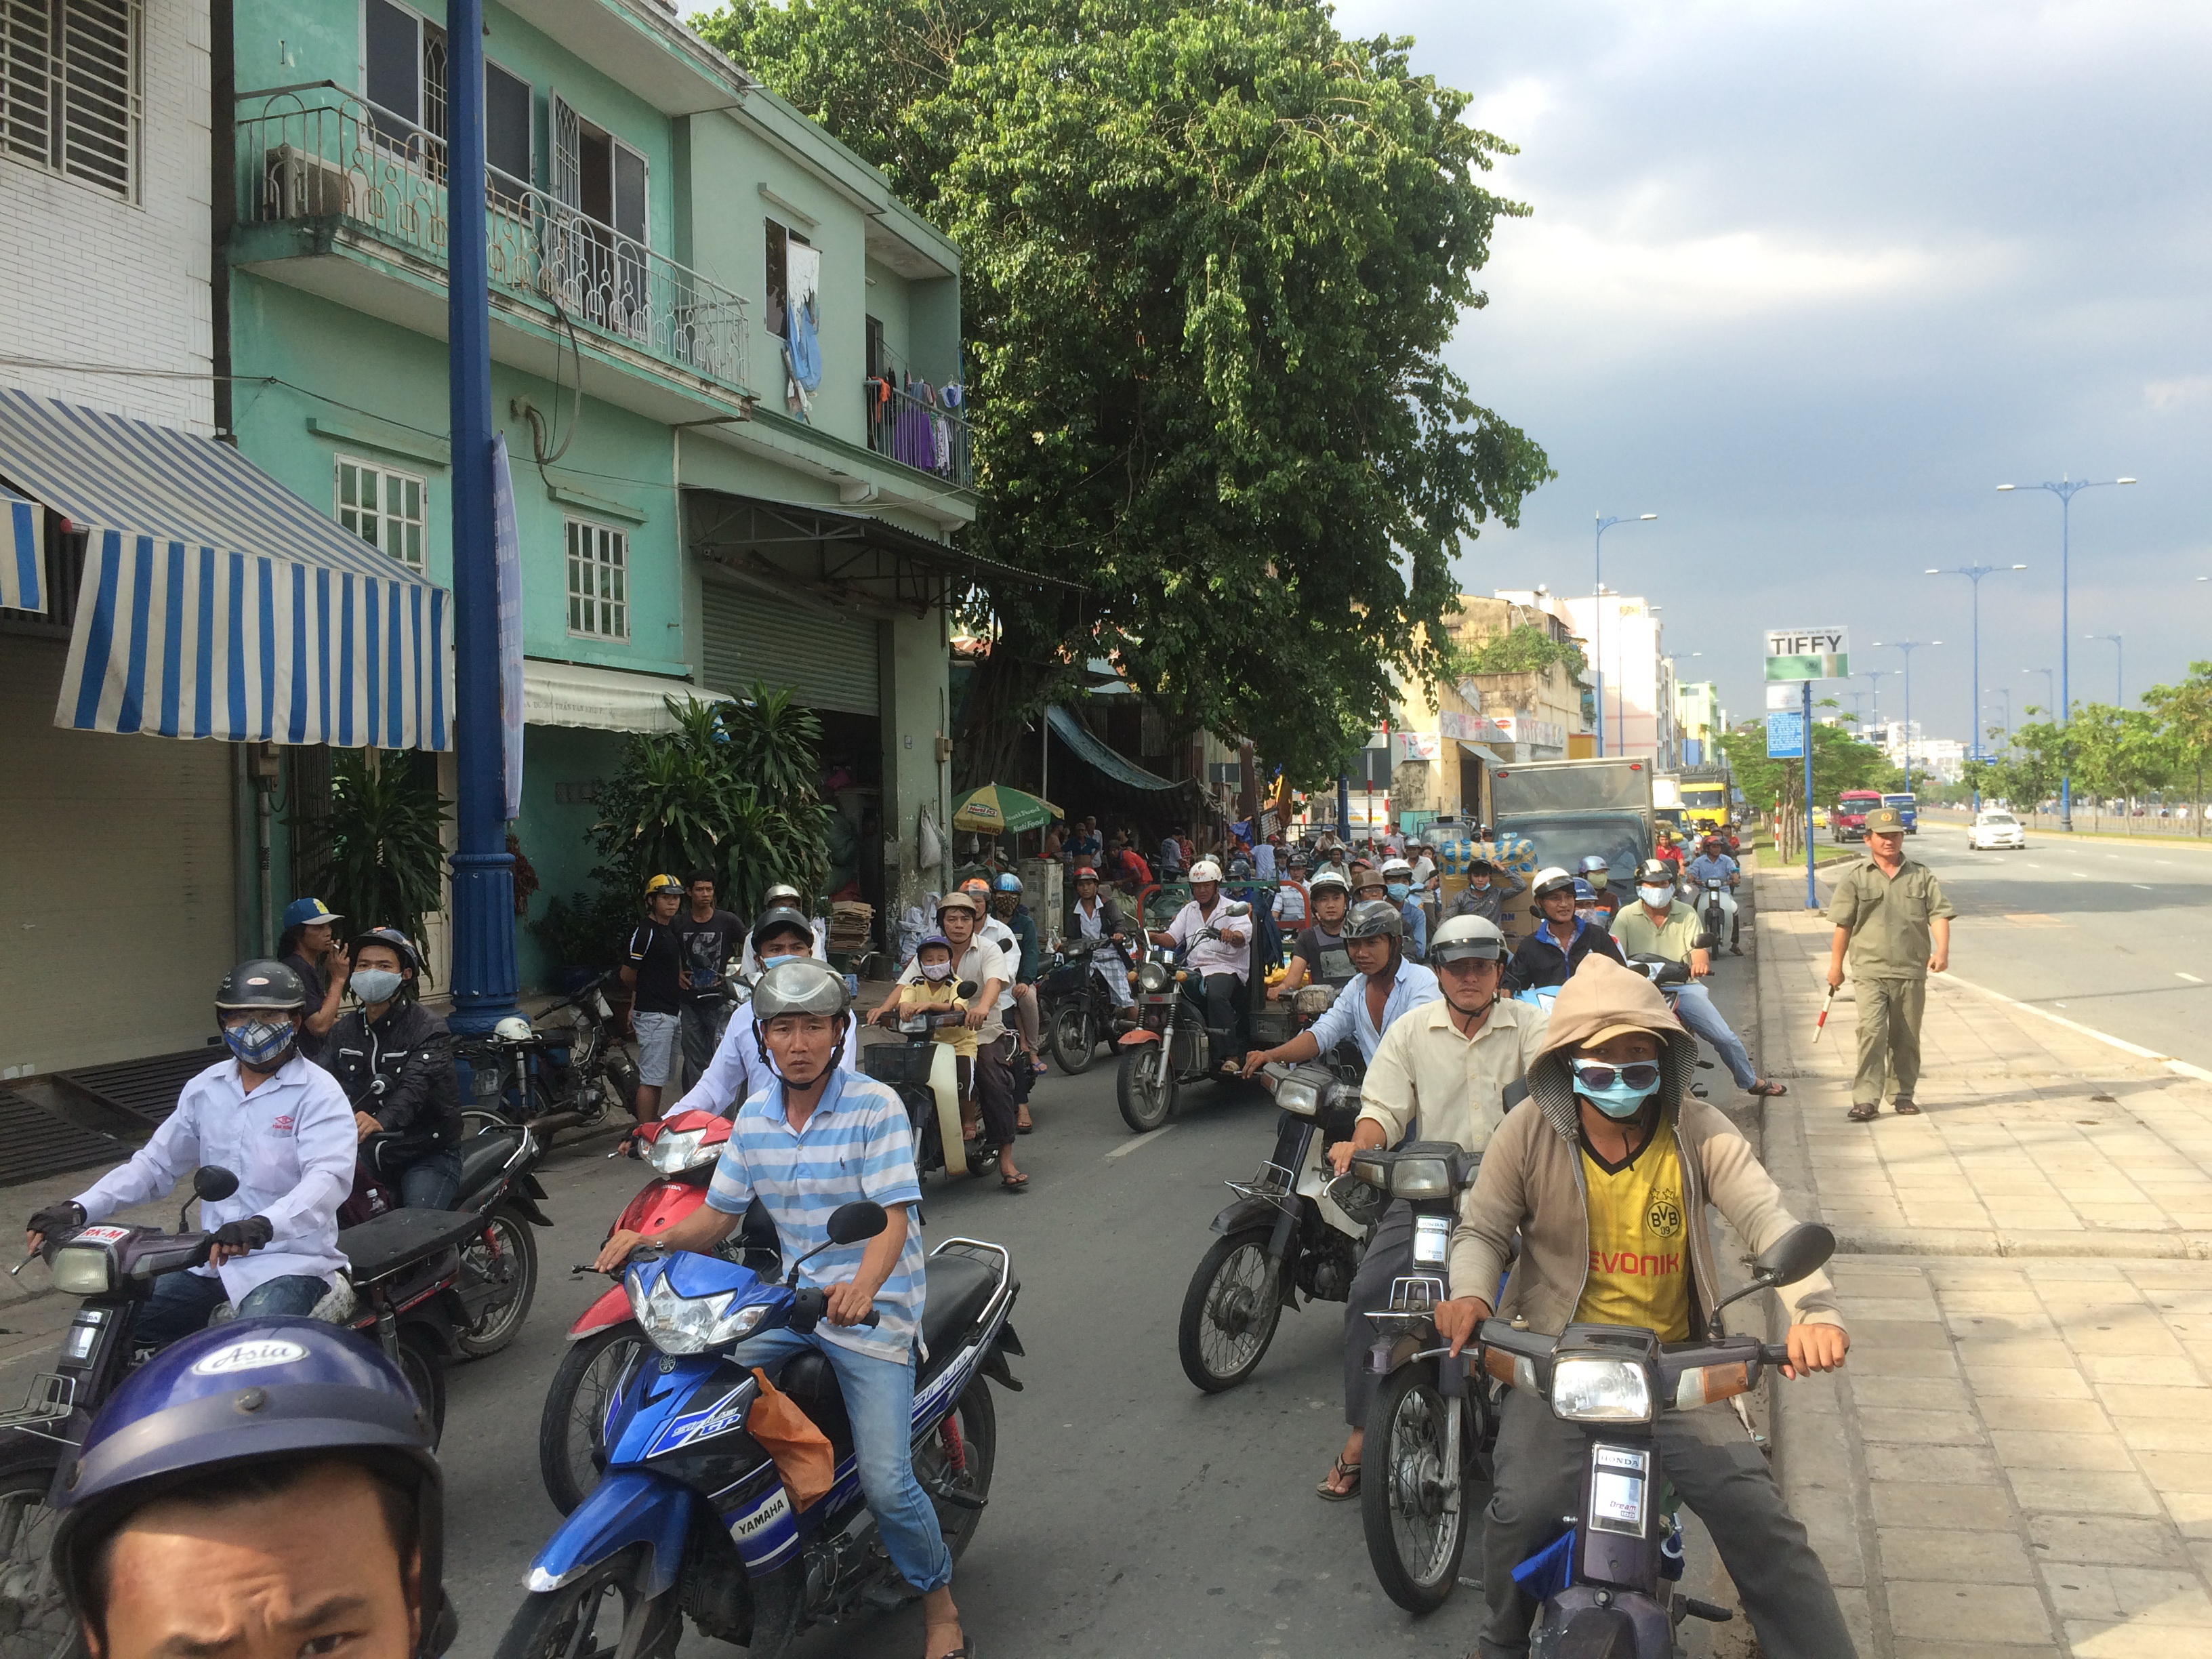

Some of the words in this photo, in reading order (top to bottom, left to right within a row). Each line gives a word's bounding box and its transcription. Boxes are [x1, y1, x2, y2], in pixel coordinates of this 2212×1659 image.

[1770, 635, 1842, 655] TIFFY
[1005, 806, 1041, 821] NutiFood
[1012, 817, 1045, 834] NutiFood
[1652, 1206, 1678, 1227] BVB
[1660, 1226, 1671, 1235] 09
[211, 1344, 291, 1369] Asia
[1601, 1456, 1639, 1467] HONDA
[1610, 1500, 1637, 1512] Dream
[738, 1498, 785, 1535] YAMAHA
